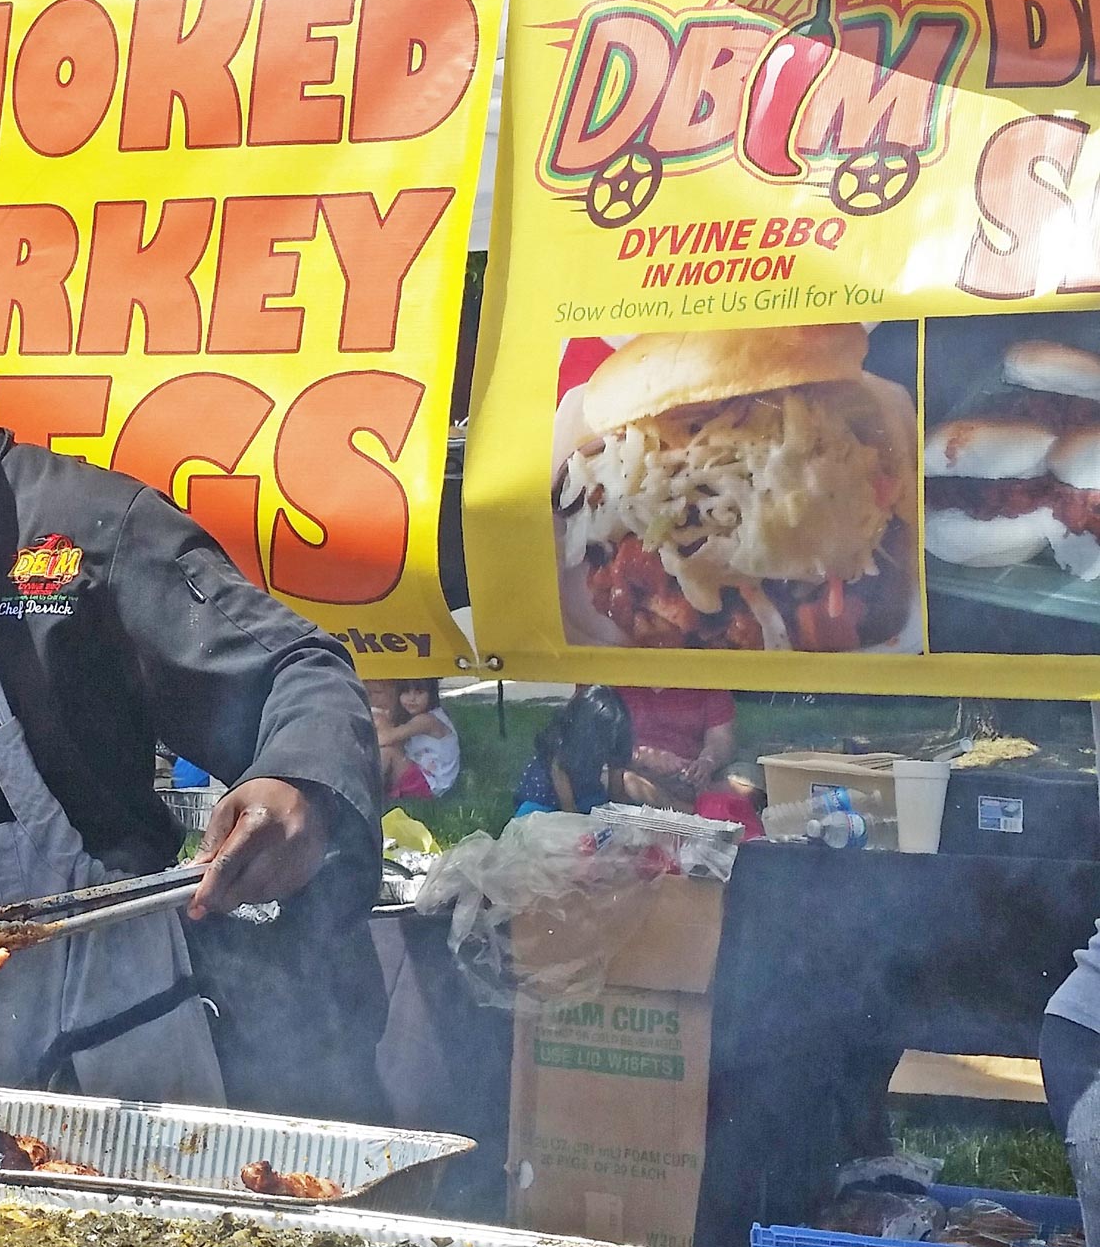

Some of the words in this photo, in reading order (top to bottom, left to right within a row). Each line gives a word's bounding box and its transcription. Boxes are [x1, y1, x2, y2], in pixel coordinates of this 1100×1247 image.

[955, 115, 1100, 300] S
[618, 222, 753, 261] DYVINE
[759, 218, 846, 249] BBQ
[641, 261, 675, 289] IN
[678, 254, 796, 287] MOTION
[555, 299, 606, 325] Slow
[610, 295, 675, 321] down,
[682, 293, 716, 316] Let
[720, 290, 748, 314] Us
[753, 287, 798, 312] Grill
[805, 283, 839, 308] for
[843, 283, 884, 306] You
[25, 599, 74, 615] Derrick
[612, 1005, 681, 1035] CUPS
[540, 1046, 572, 1064] USE
